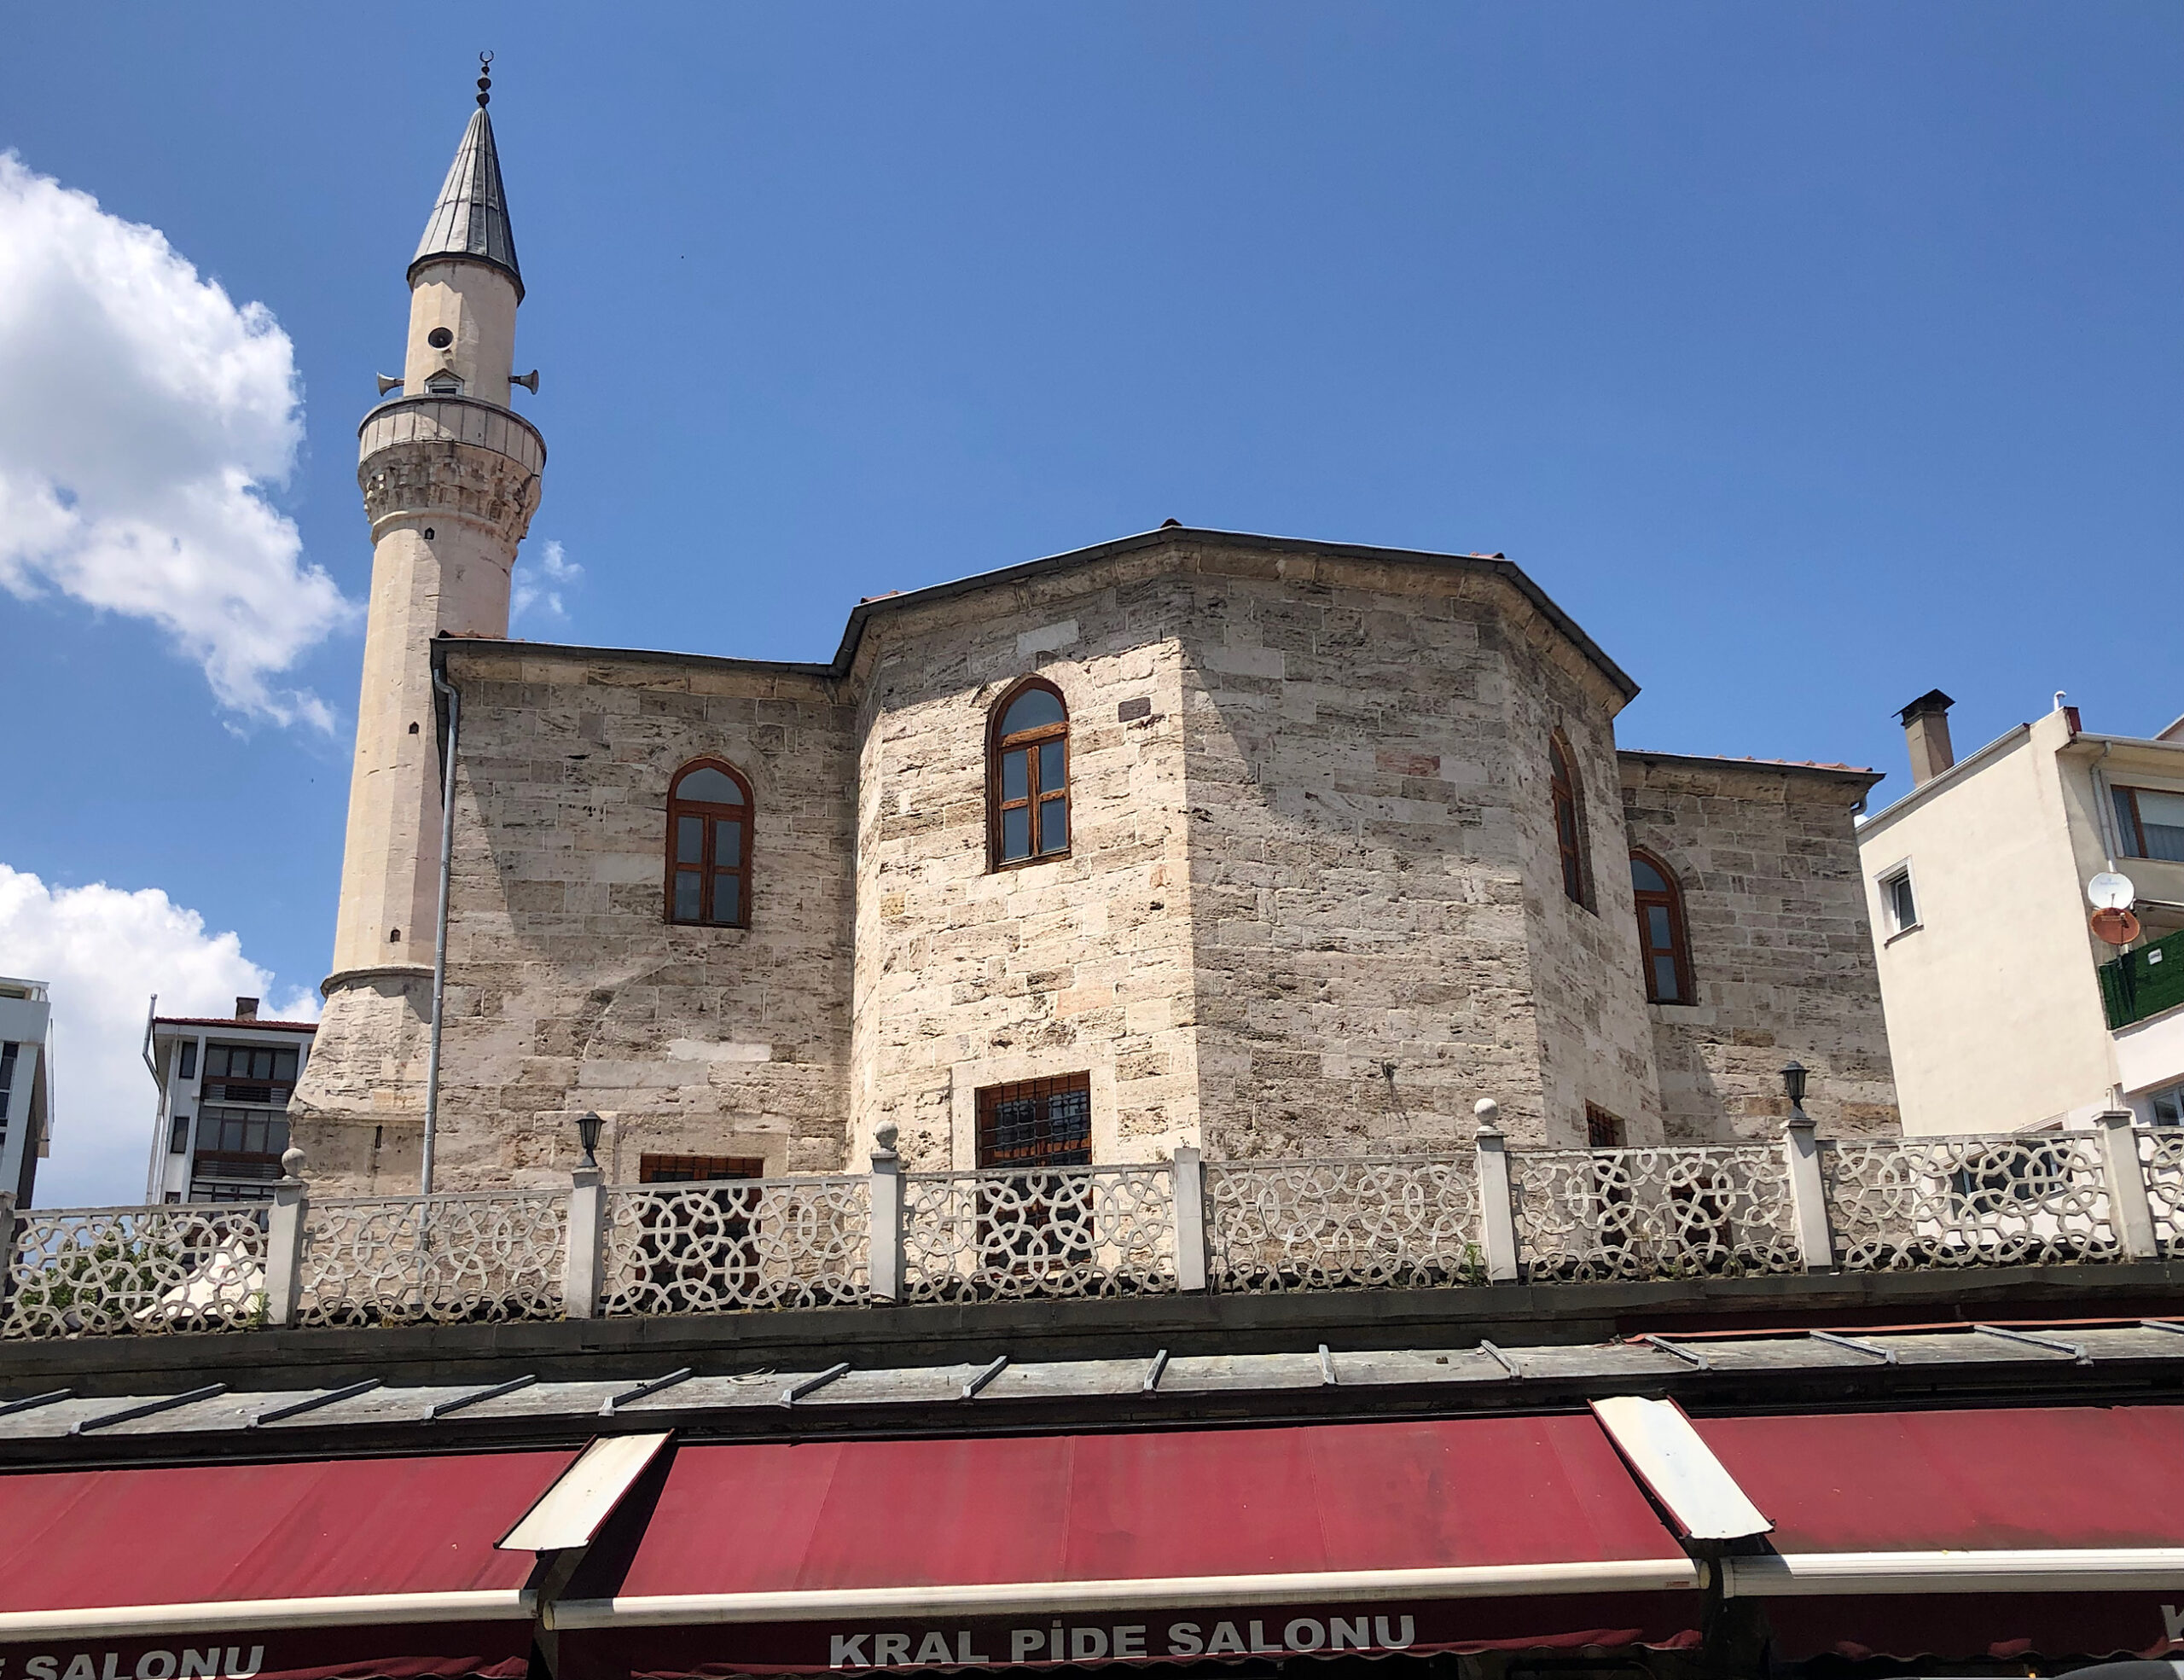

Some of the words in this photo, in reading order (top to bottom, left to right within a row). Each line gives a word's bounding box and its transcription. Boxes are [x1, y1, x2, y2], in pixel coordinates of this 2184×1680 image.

[22, 1645, 264, 1680] SALONU
[829, 1631, 989, 1669] KRAL
[1011, 1619, 1147, 1663] PİDE
[1167, 1615, 1415, 1657] SALONU
